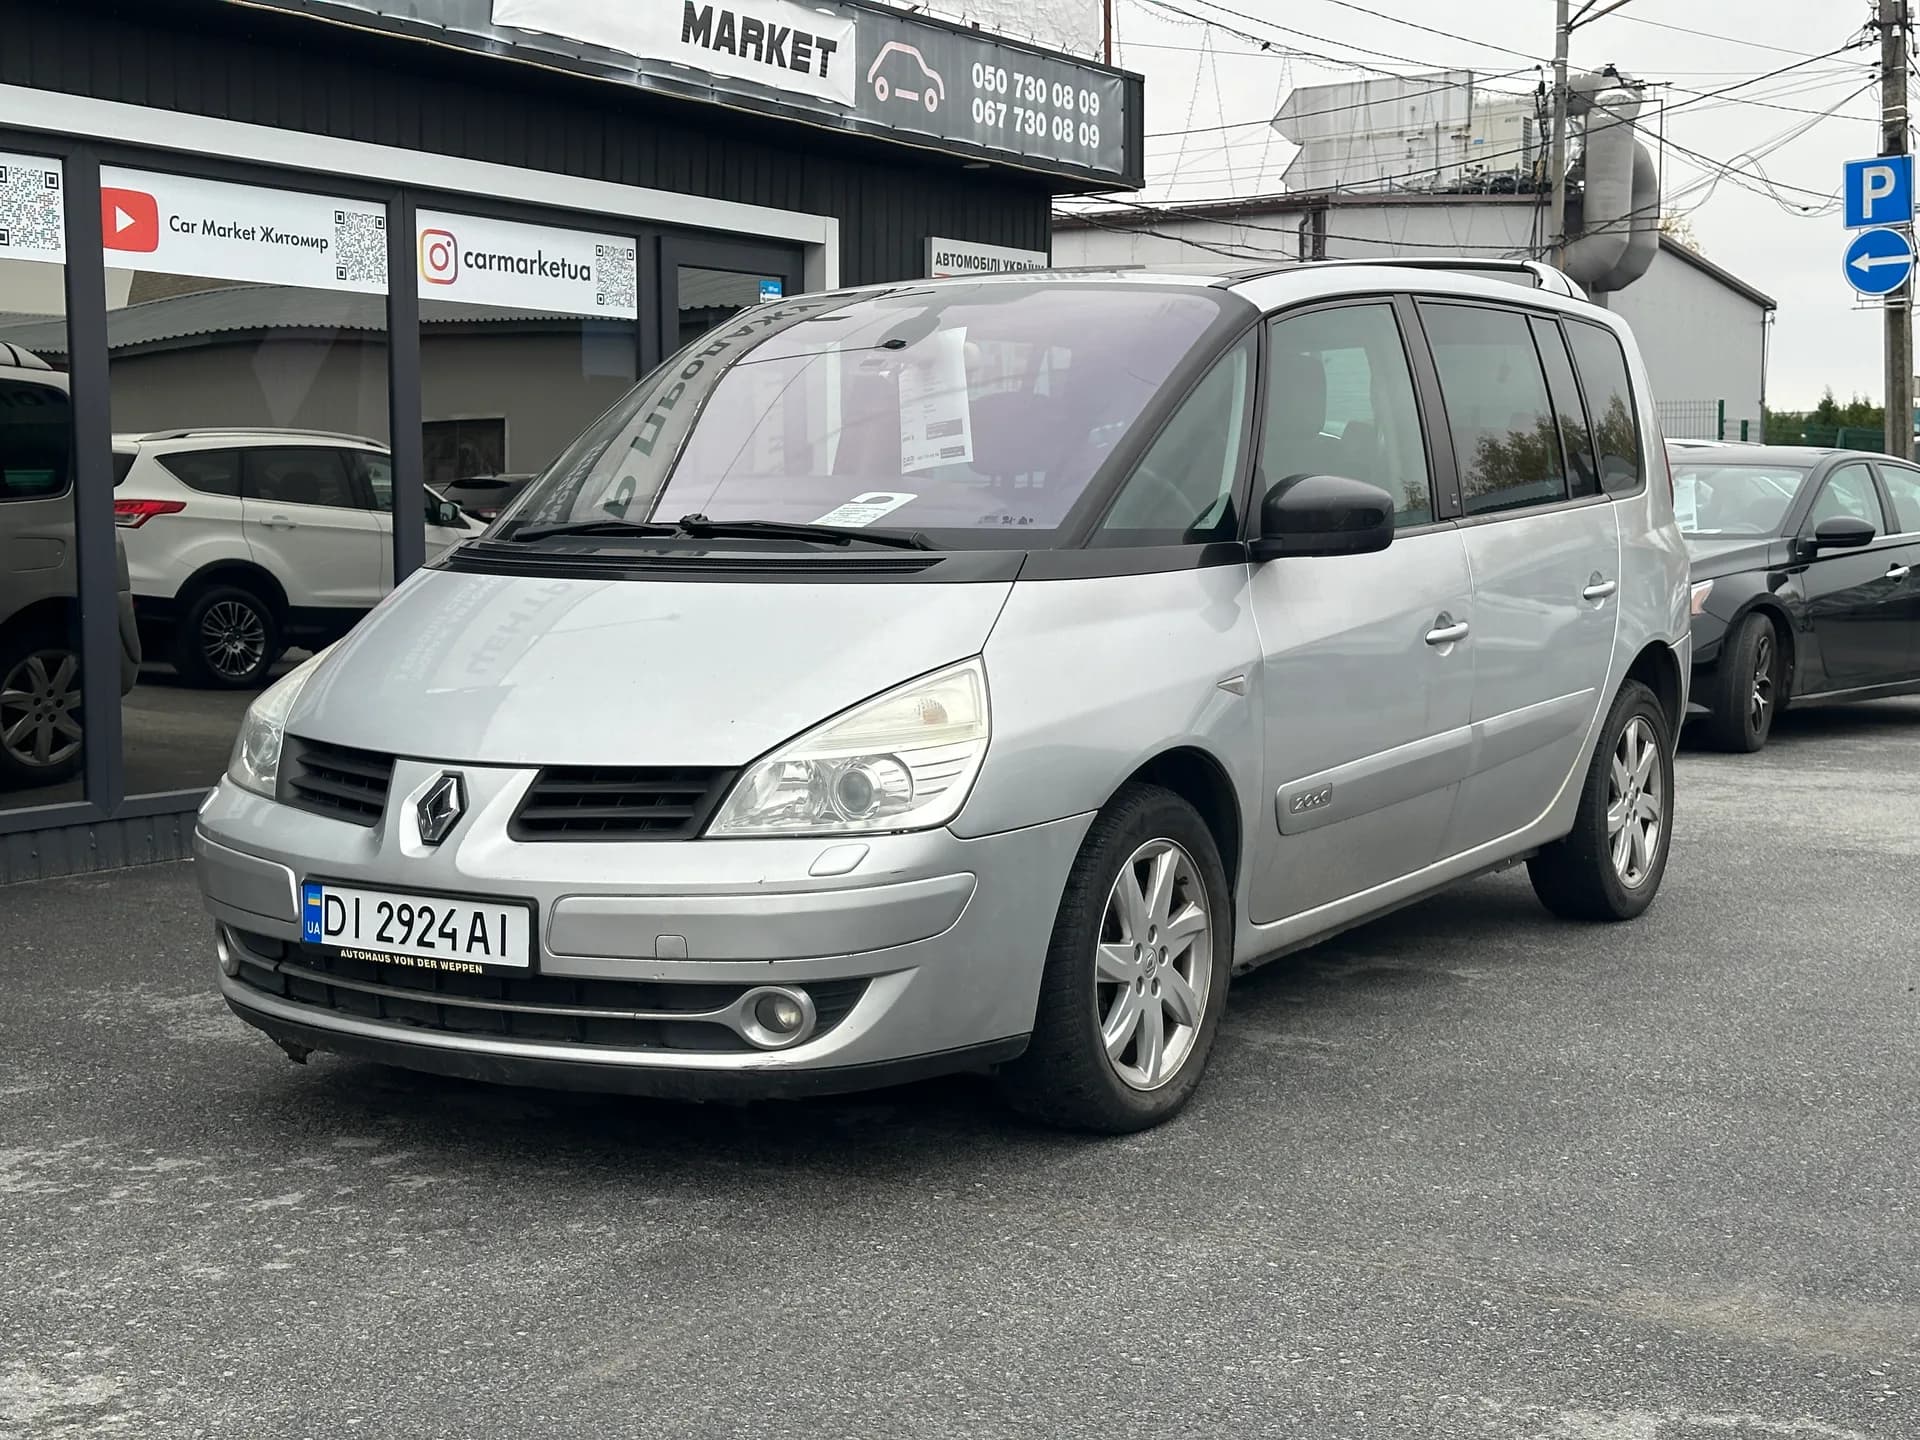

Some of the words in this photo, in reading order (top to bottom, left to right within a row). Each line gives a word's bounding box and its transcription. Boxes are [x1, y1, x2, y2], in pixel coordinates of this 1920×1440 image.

[681, 0, 838, 78] MARKET
[972, 62, 1008, 95] 050
[1013, 72, 1047, 104] 730
[1052, 82, 1074, 110] 08
[1078, 89, 1100, 117] 09
[972, 97, 1008, 129] 067
[1013, 106, 1047, 137] 730
[1052, 115, 1074, 143] 08
[1078, 122, 1100, 149] 09
[1862, 165, 1896, 219] P
[169, 215, 198, 234] Car
[202, 218, 256, 241] Market
[260, 226, 329, 254] Житомир
[464, 249, 591, 282] carmarketua
[935, 252, 1000, 273] АВТОМОБІЛІ
[1003, 259, 1045, 272] УКРАЇ
[307, 921, 321, 935] UA
[324, 893, 360, 939] DI
[340, 949, 391, 964] AUTOHAUS
[394, 955, 414, 967] VON
[417, 957, 438, 969] DER
[439, 960, 483, 975] WEPPEN
